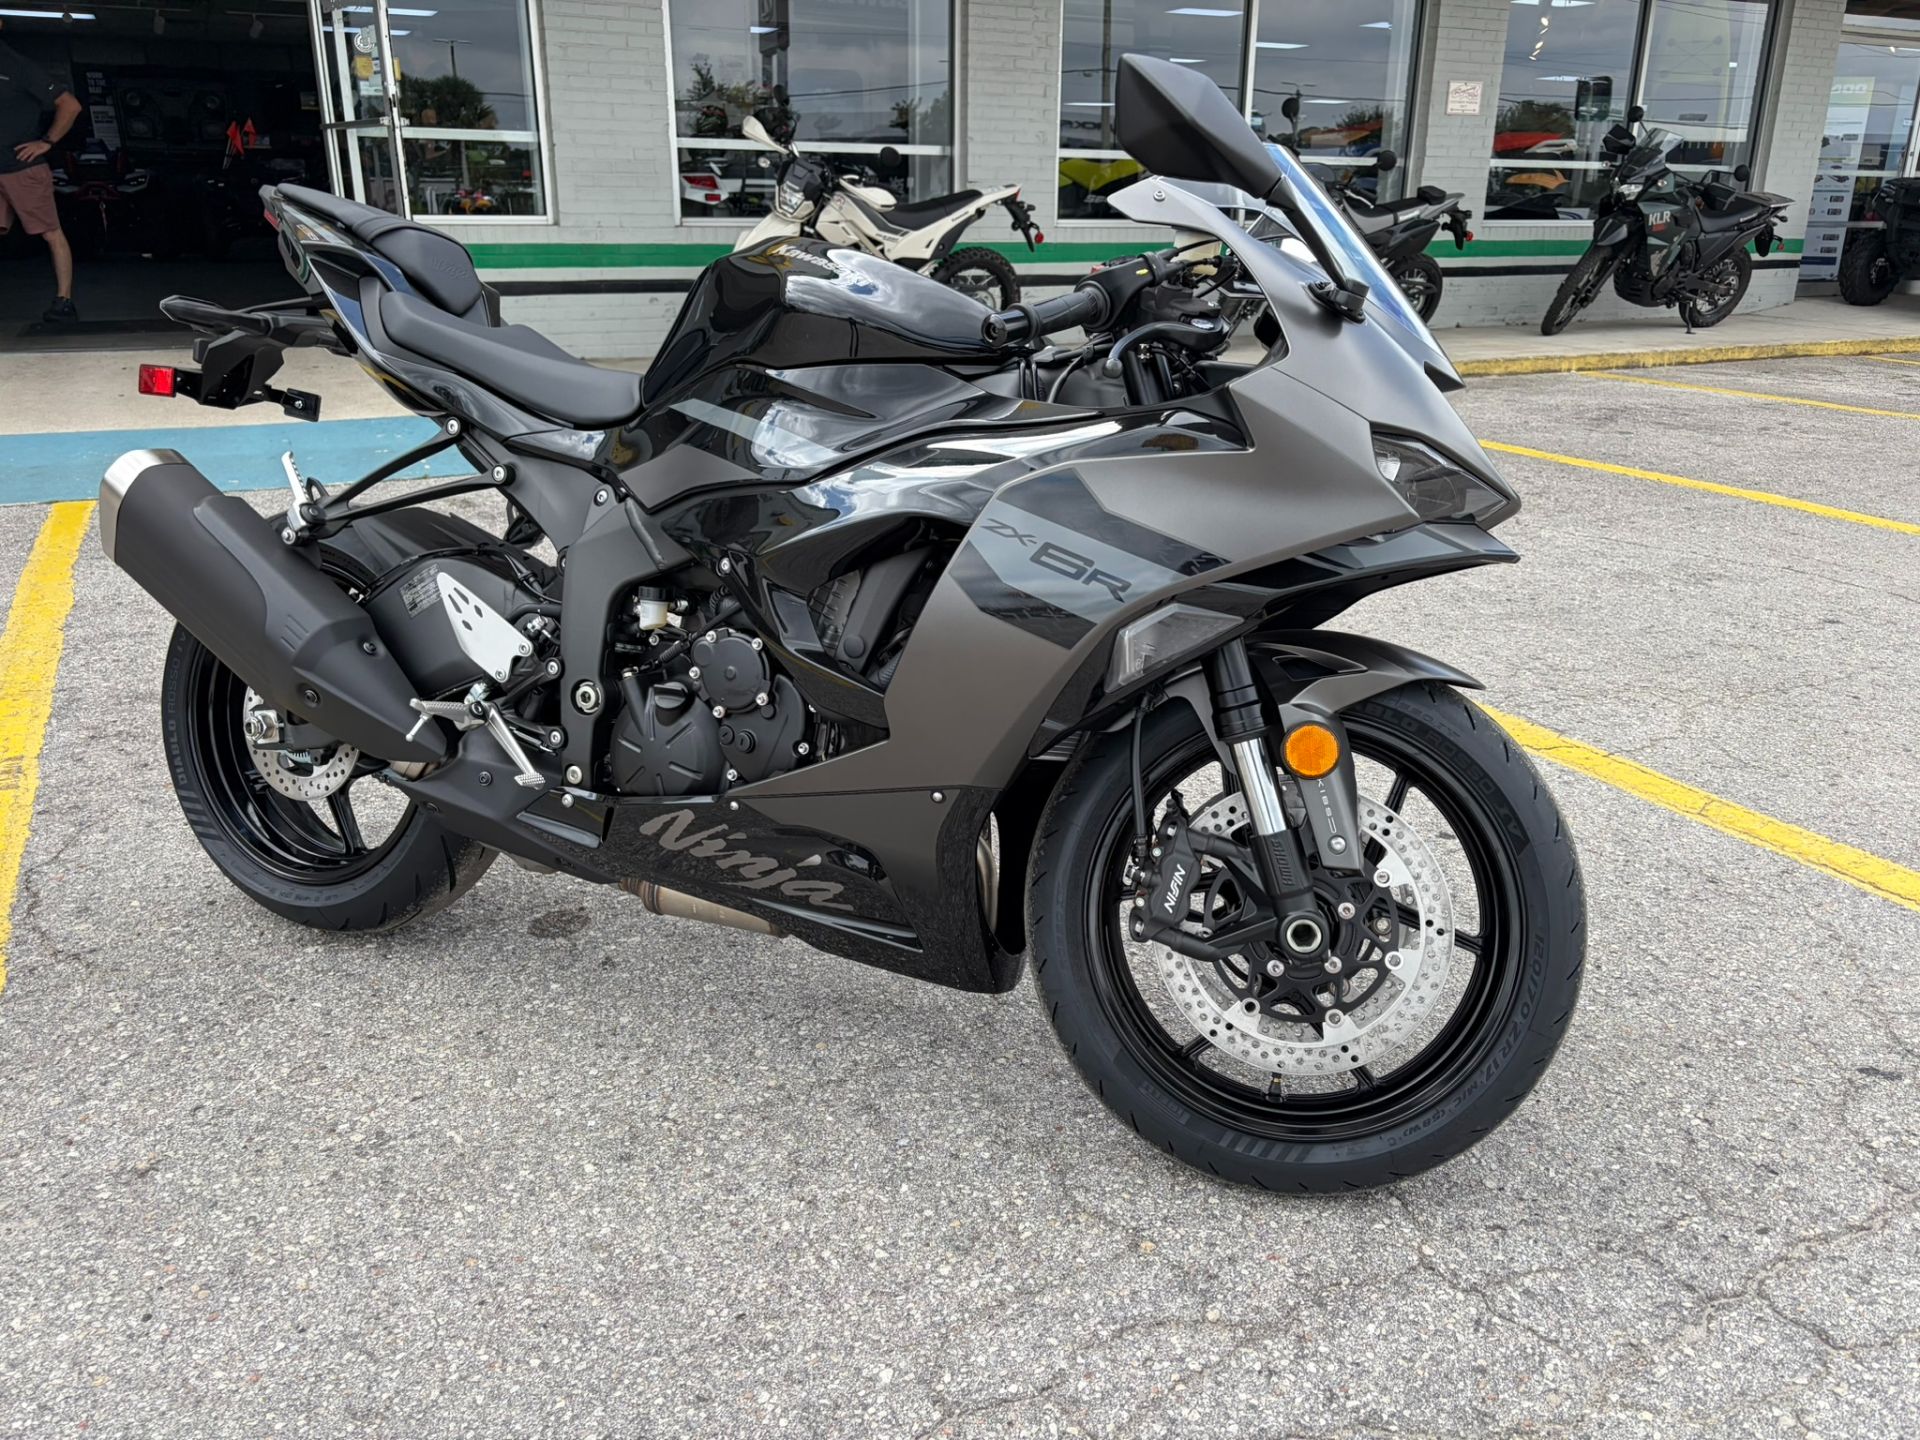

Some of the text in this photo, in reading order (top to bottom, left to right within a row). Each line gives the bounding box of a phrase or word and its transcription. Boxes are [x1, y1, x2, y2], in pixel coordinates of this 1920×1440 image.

[1648, 211, 1671, 226] KLR
[772, 244, 868, 280] Kawasa
[980, 518, 1133, 604] ZX-6R
[168, 658, 180, 714] ROSSO
[168, 719, 188, 785] DIABLO
[639, 809, 854, 911] Ninja
[1164, 864, 1187, 914] NISSIN
